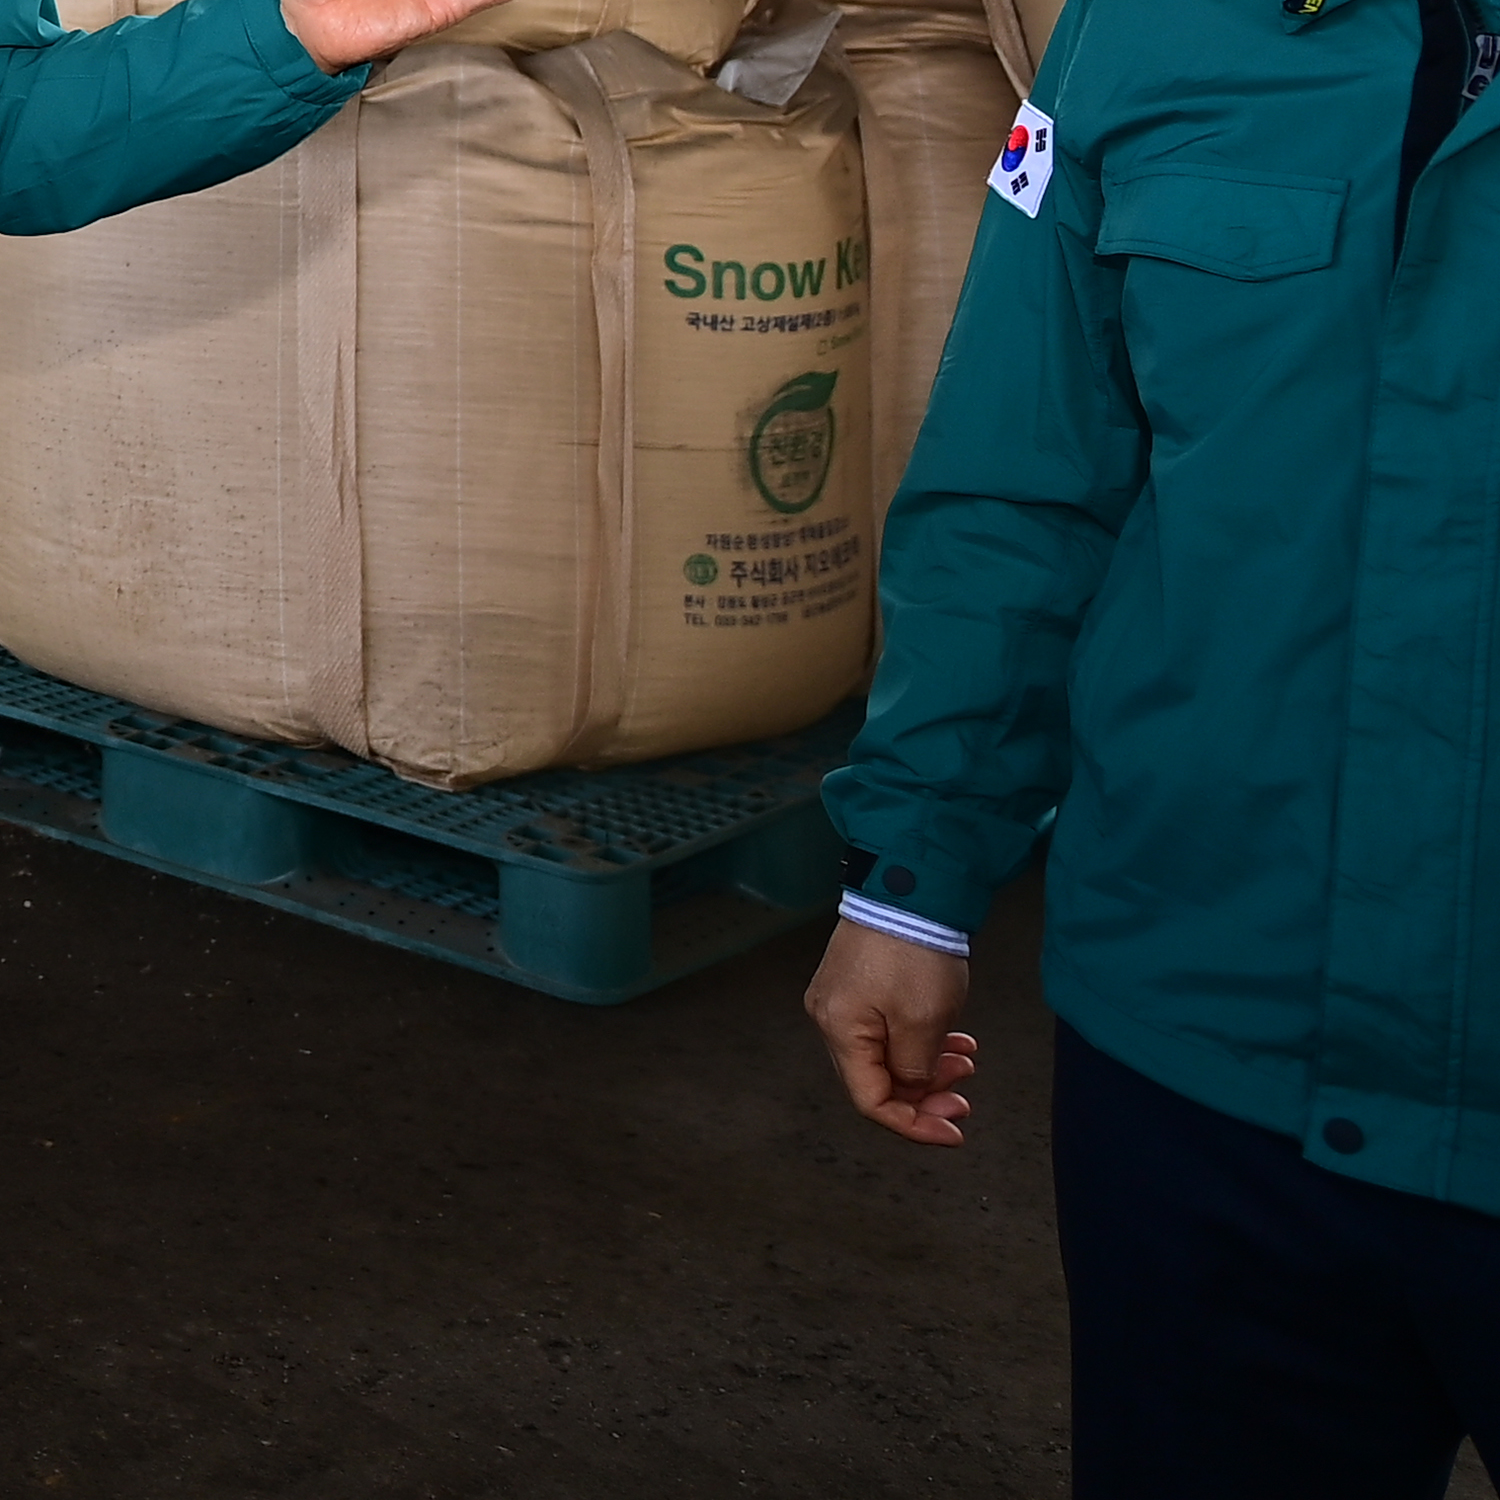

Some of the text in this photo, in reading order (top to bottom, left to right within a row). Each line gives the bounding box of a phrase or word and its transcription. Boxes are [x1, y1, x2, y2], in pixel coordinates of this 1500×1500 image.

[664, 243, 827, 301] Snow
[686, 311, 735, 332] 국내산
[730, 556, 799, 588] 주식회사
